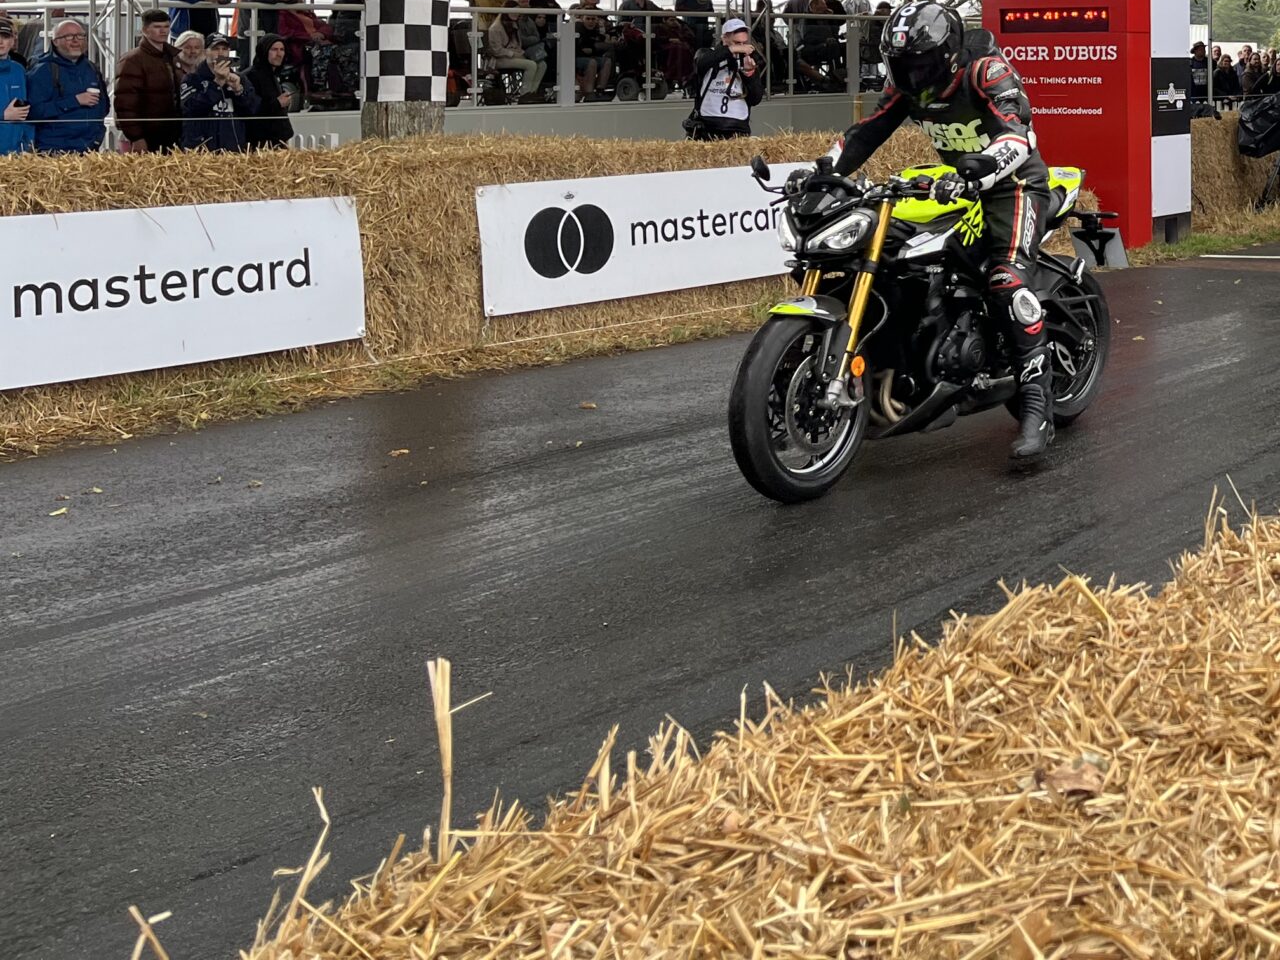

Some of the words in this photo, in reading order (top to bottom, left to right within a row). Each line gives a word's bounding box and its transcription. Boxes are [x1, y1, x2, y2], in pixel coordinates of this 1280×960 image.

[999, 46, 1049, 61] OGER
[1053, 45, 1117, 61] DUBUIS
[1021, 76, 1037, 84] CIAL
[1039, 76, 1066, 84] TIMING
[1068, 76, 1102, 84] PARTNER
[720, 96, 729, 114] 8
[1030, 107, 1102, 115] DubuisXGoodwood
[630, 205, 780, 246] mastercar
[1022, 195, 1036, 258] RST
[13, 247, 312, 318] mastercard
